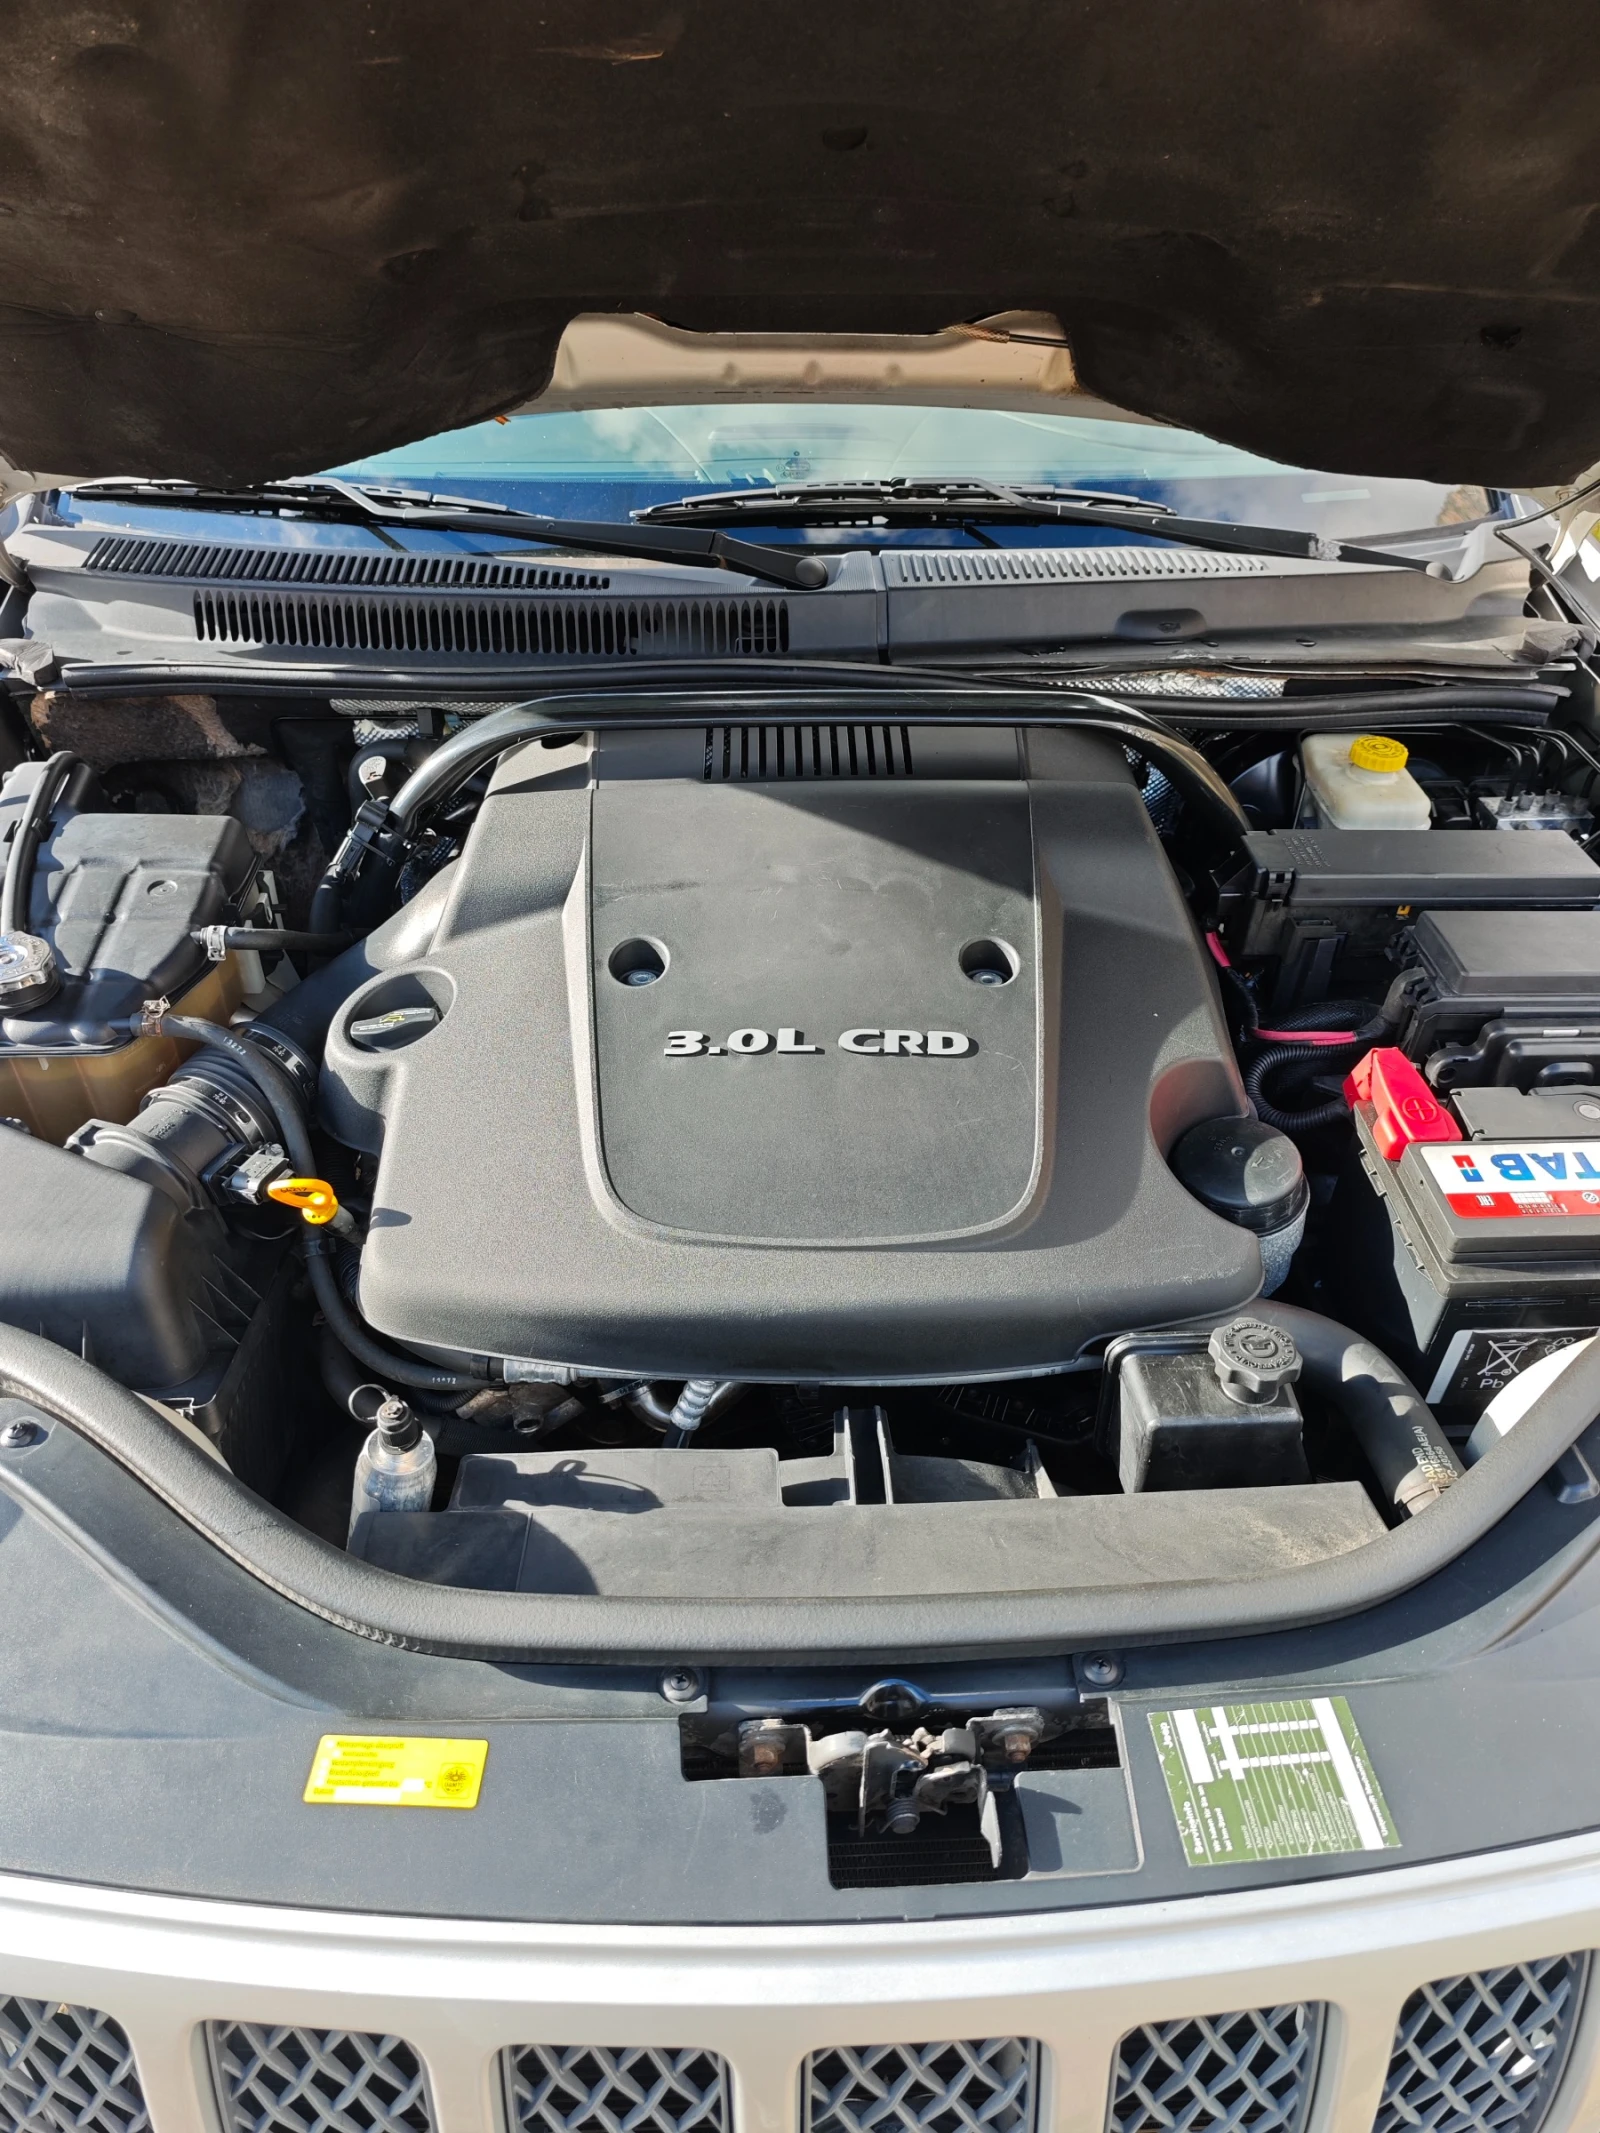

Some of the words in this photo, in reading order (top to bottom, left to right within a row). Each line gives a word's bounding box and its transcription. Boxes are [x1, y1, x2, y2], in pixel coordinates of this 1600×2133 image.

[664, 1028, 816, 1056] 3.0L
[838, 1028, 970, 1055] CRD
[1490, 1152, 1600, 1181] TAB
[1479, 1378, 1504, 1389] Pb
[1411, 1447, 1428, 1465] END
[1157, 1721, 1175, 1747] Jeep
[1180, 1800, 1205, 1854] Serviceinfo
